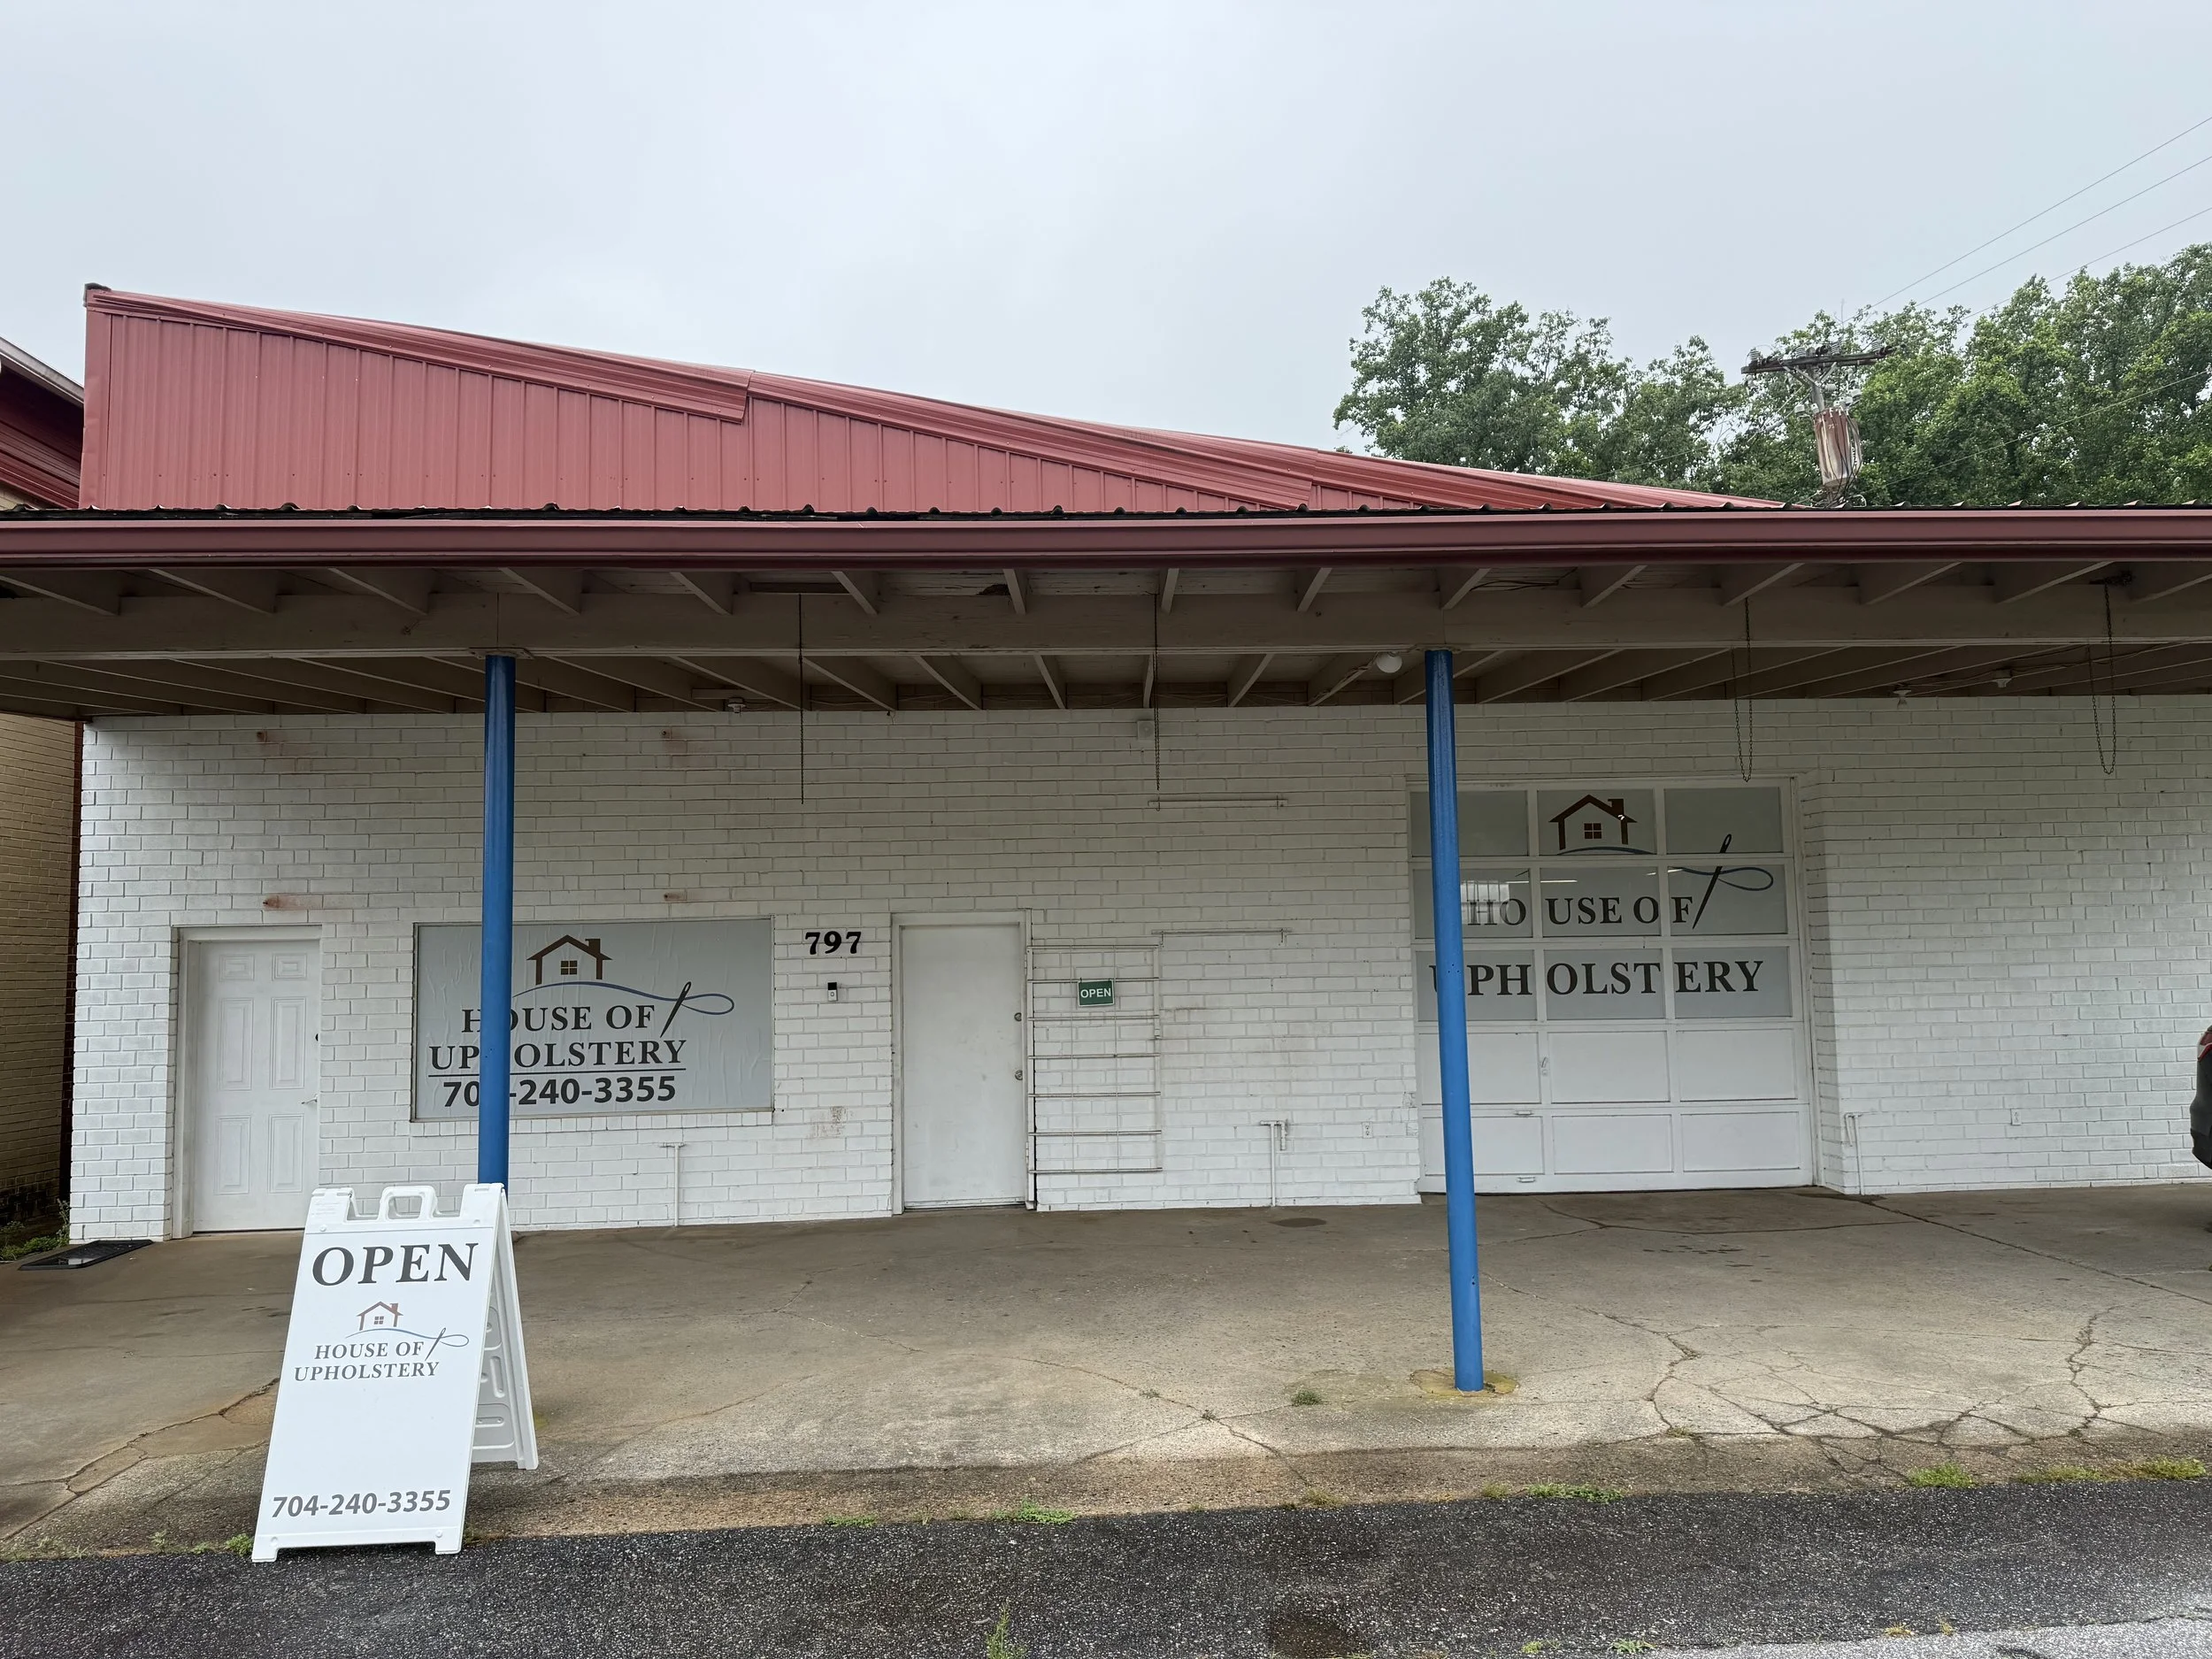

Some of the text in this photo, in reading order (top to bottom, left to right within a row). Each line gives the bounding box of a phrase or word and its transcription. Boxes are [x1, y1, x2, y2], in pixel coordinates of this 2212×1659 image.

[1468, 895, 1693, 926] HOUSE OF
[805, 931, 862, 955] 797
[1429, 960, 1763, 996] PHOLSTERY
[1080, 987, 1111, 999] OPEN
[606, 1004, 655, 1029] OF
[429, 1039, 687, 1070] UPOLSTERY
[443, 1075, 676, 1107] 70-240-3355
[312, 1242, 479, 1286] OPEN
[315, 1341, 425, 1360] HOUSE OF
[294, 1361, 440, 1382] UPHOLSTERY
[272, 1490, 451, 1518] 704-240-3355
